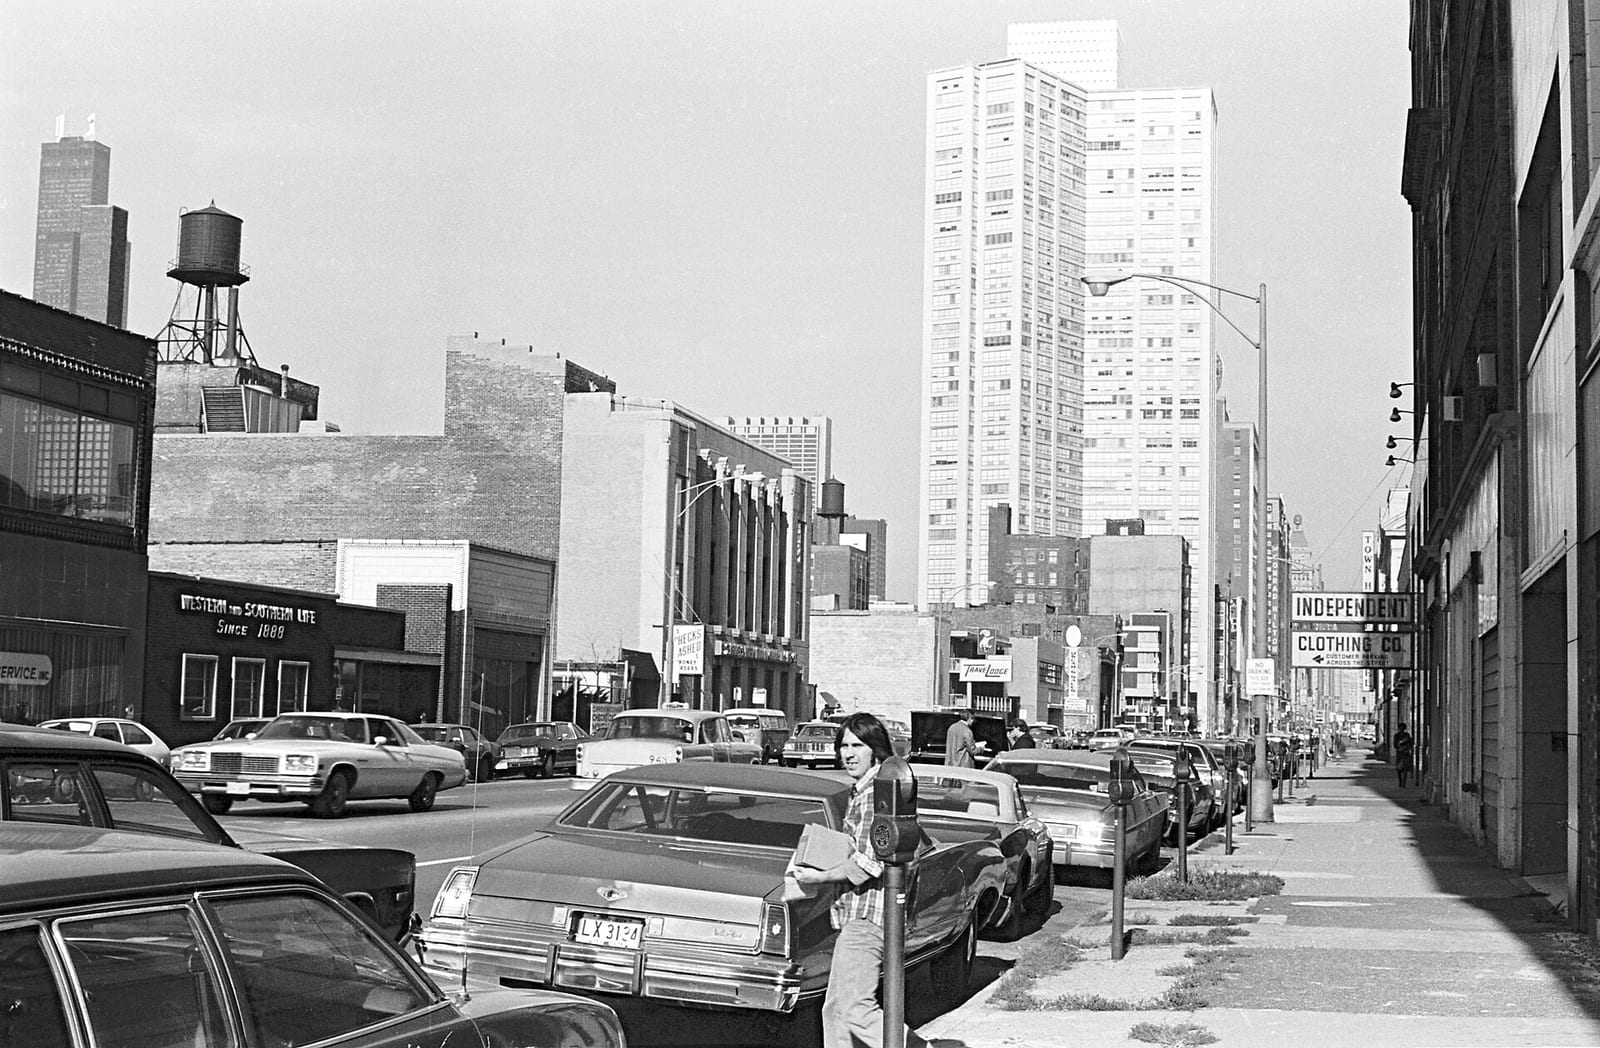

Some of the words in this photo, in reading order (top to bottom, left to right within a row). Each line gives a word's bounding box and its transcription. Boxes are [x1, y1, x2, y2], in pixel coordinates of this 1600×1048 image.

[1364, 535, 1372, 573] TOWN
[180, 594, 227, 614] WESTERN
[244, 602, 294, 621] SOUTHERN
[297, 608, 316, 624] LIFE
[1296, 597, 1407, 618] INDEPENDENT
[257, 623, 285, 639] 1888
[1298, 636, 1372, 652] CLOTHING
[1381, 637, 1406, 652] CO.
